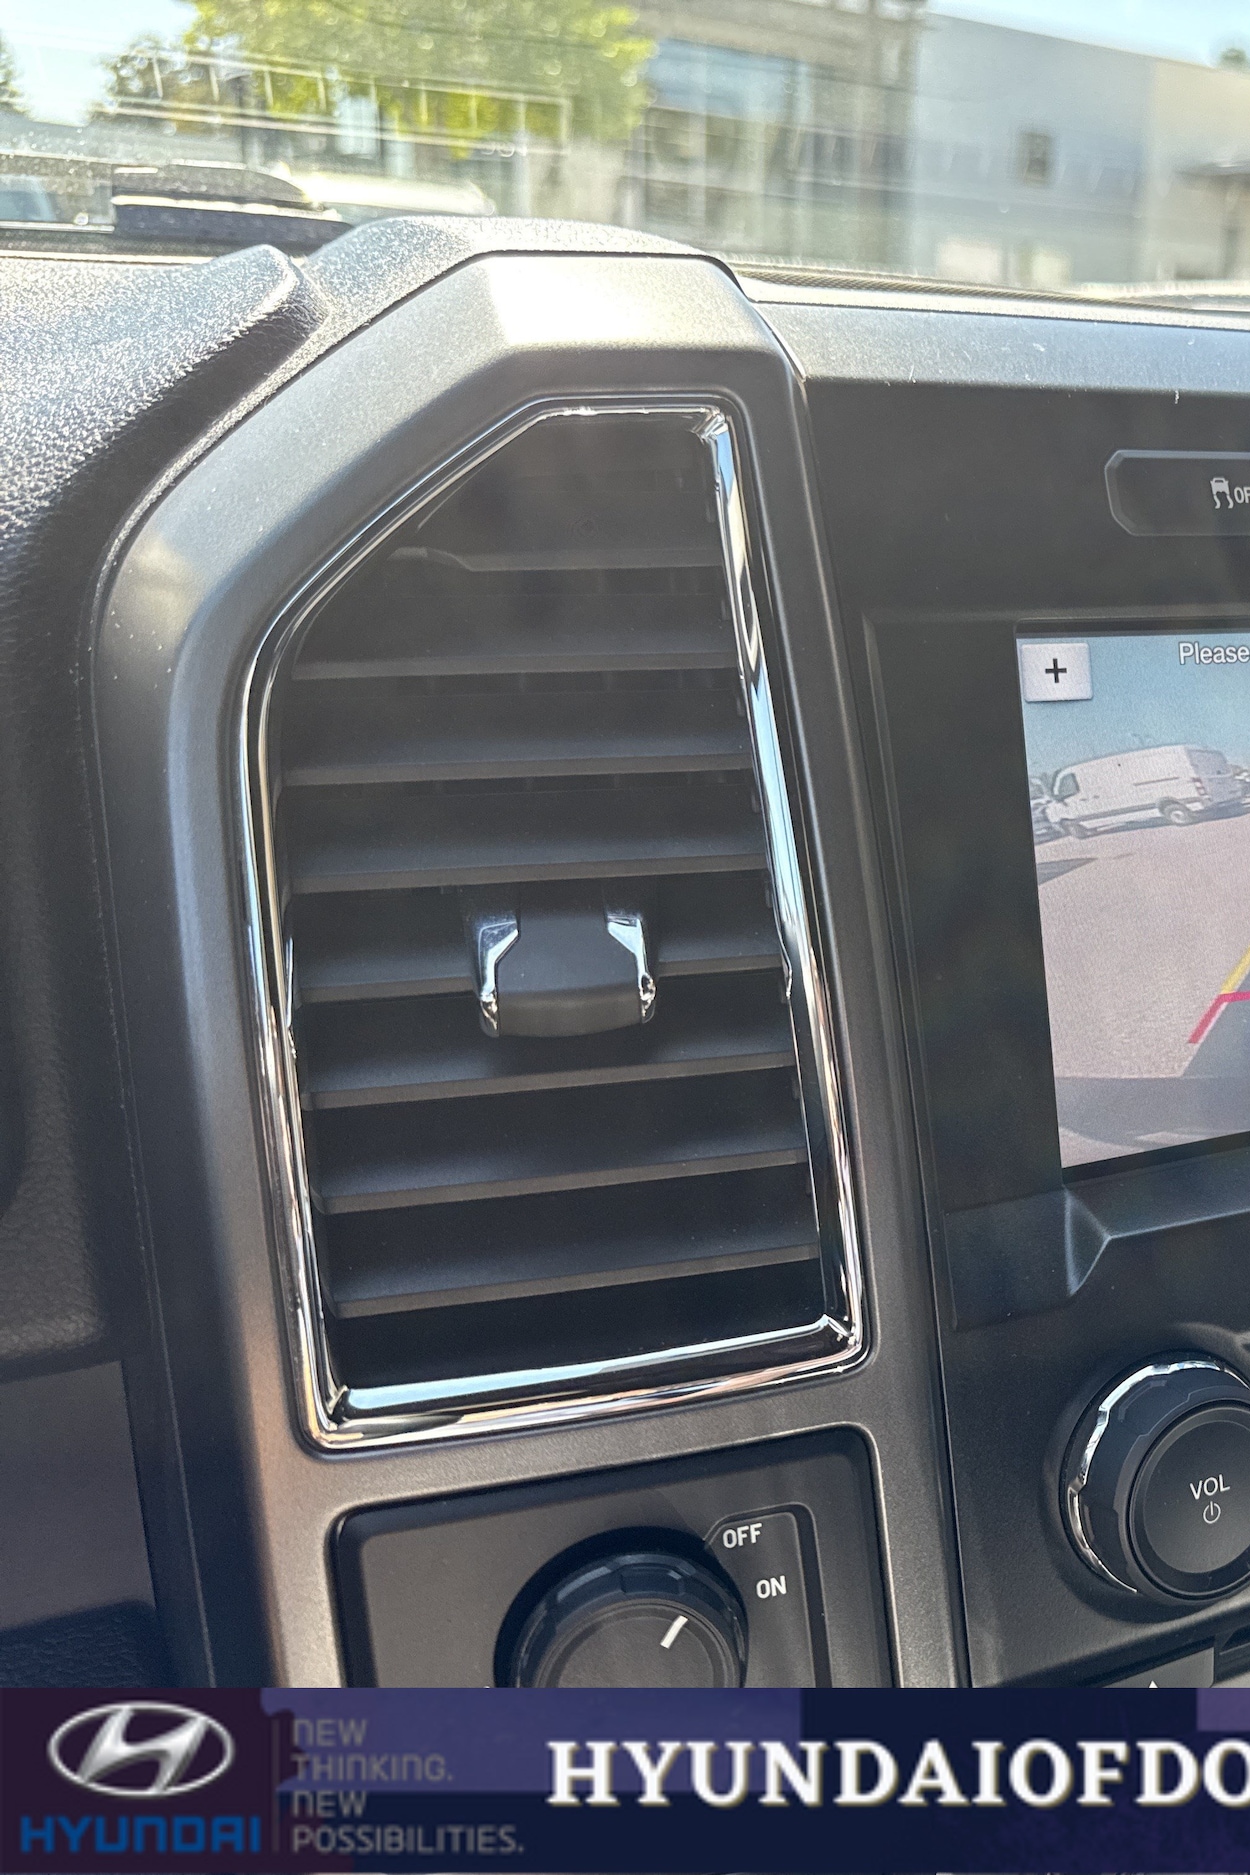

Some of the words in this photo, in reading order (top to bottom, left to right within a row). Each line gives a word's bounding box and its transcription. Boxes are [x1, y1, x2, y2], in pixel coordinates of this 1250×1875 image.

[1178, 641, 1250, 665] Please
[1190, 1474, 1231, 1500] VOL
[722, 1522, 763, 1549] OFF
[755, 1575, 788, 1599] ON
